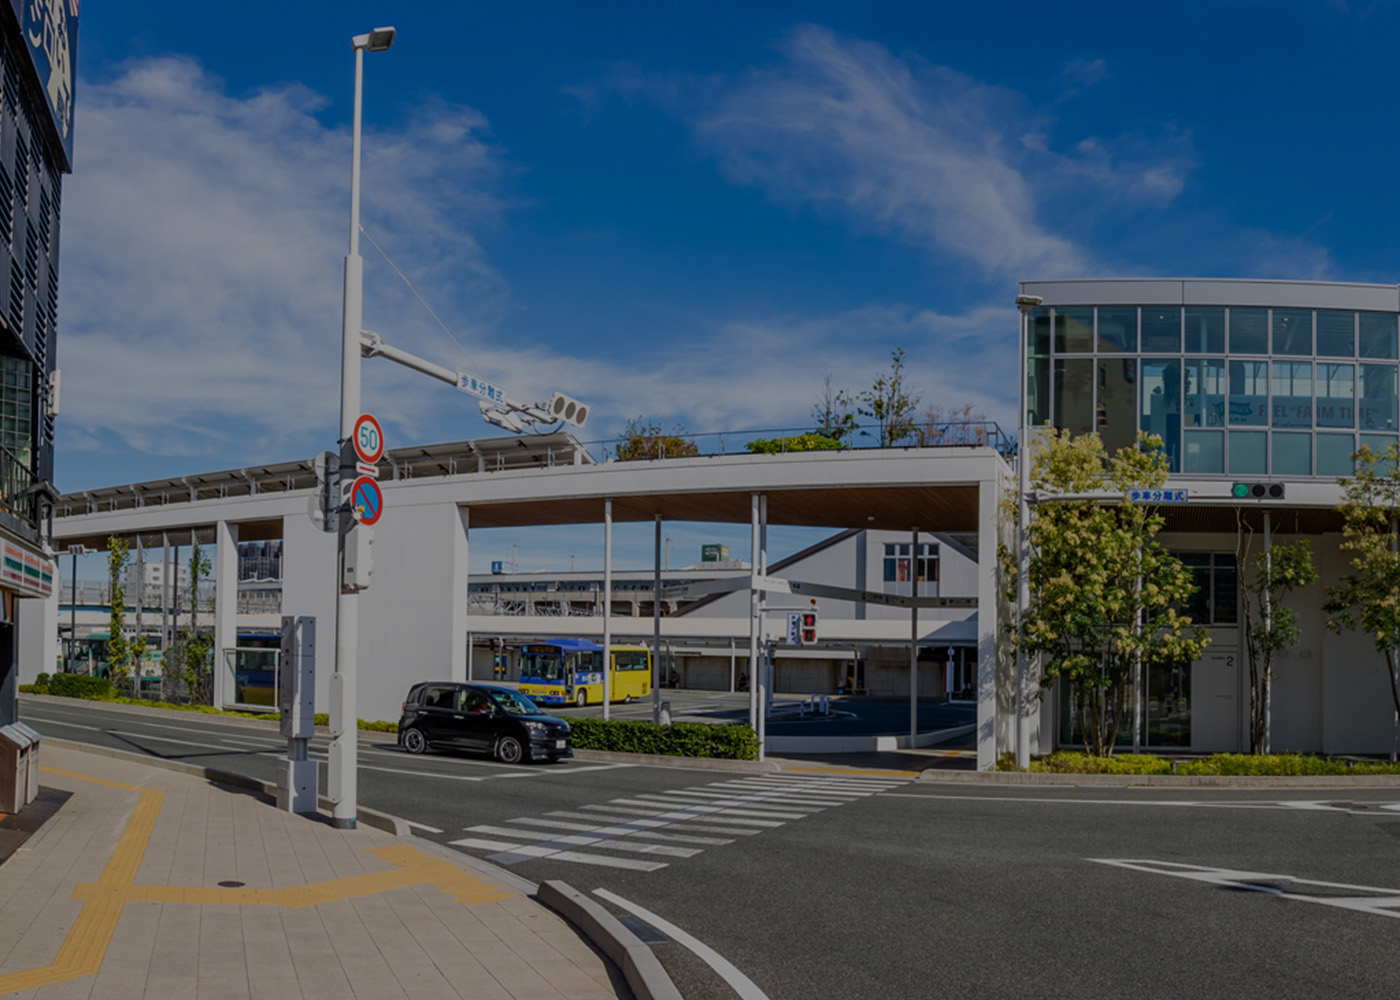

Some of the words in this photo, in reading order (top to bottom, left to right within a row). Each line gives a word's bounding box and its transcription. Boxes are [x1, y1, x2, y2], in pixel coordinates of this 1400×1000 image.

[461, 375, 503, 403] 歩車分離式
[1259, 404, 1288, 417] FEL
[360, 426, 377, 450] 50
[1132, 490, 1184, 501] 歩車分離式
[1227, 656, 1234, 667] 2
